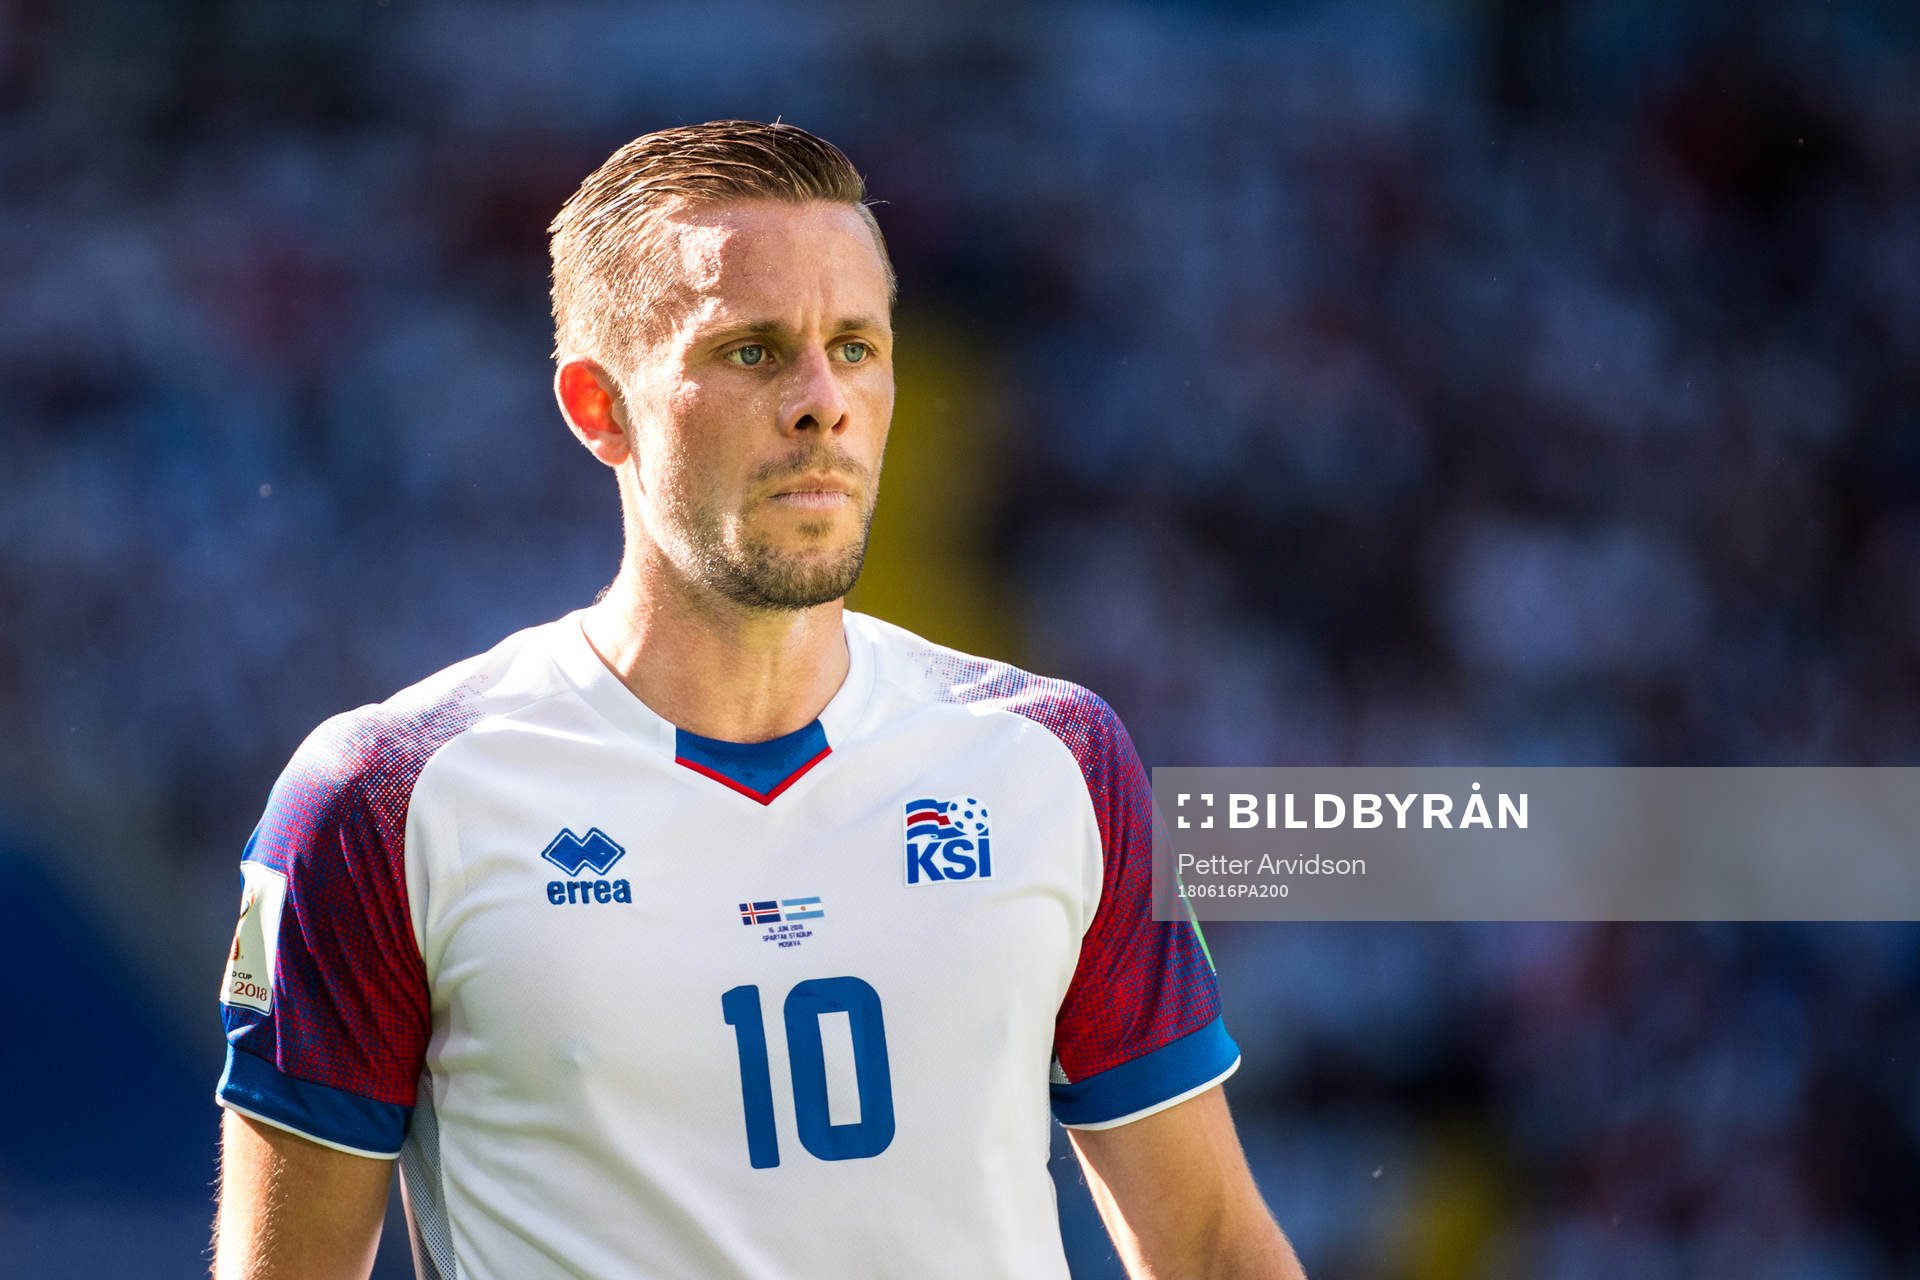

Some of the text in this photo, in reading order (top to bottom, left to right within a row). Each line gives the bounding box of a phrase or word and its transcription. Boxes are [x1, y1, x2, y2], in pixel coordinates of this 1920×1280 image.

[238, 971, 252, 980] CUP
[233, 981, 267, 1001] 2018
[721, 976, 896, 1169] 10
